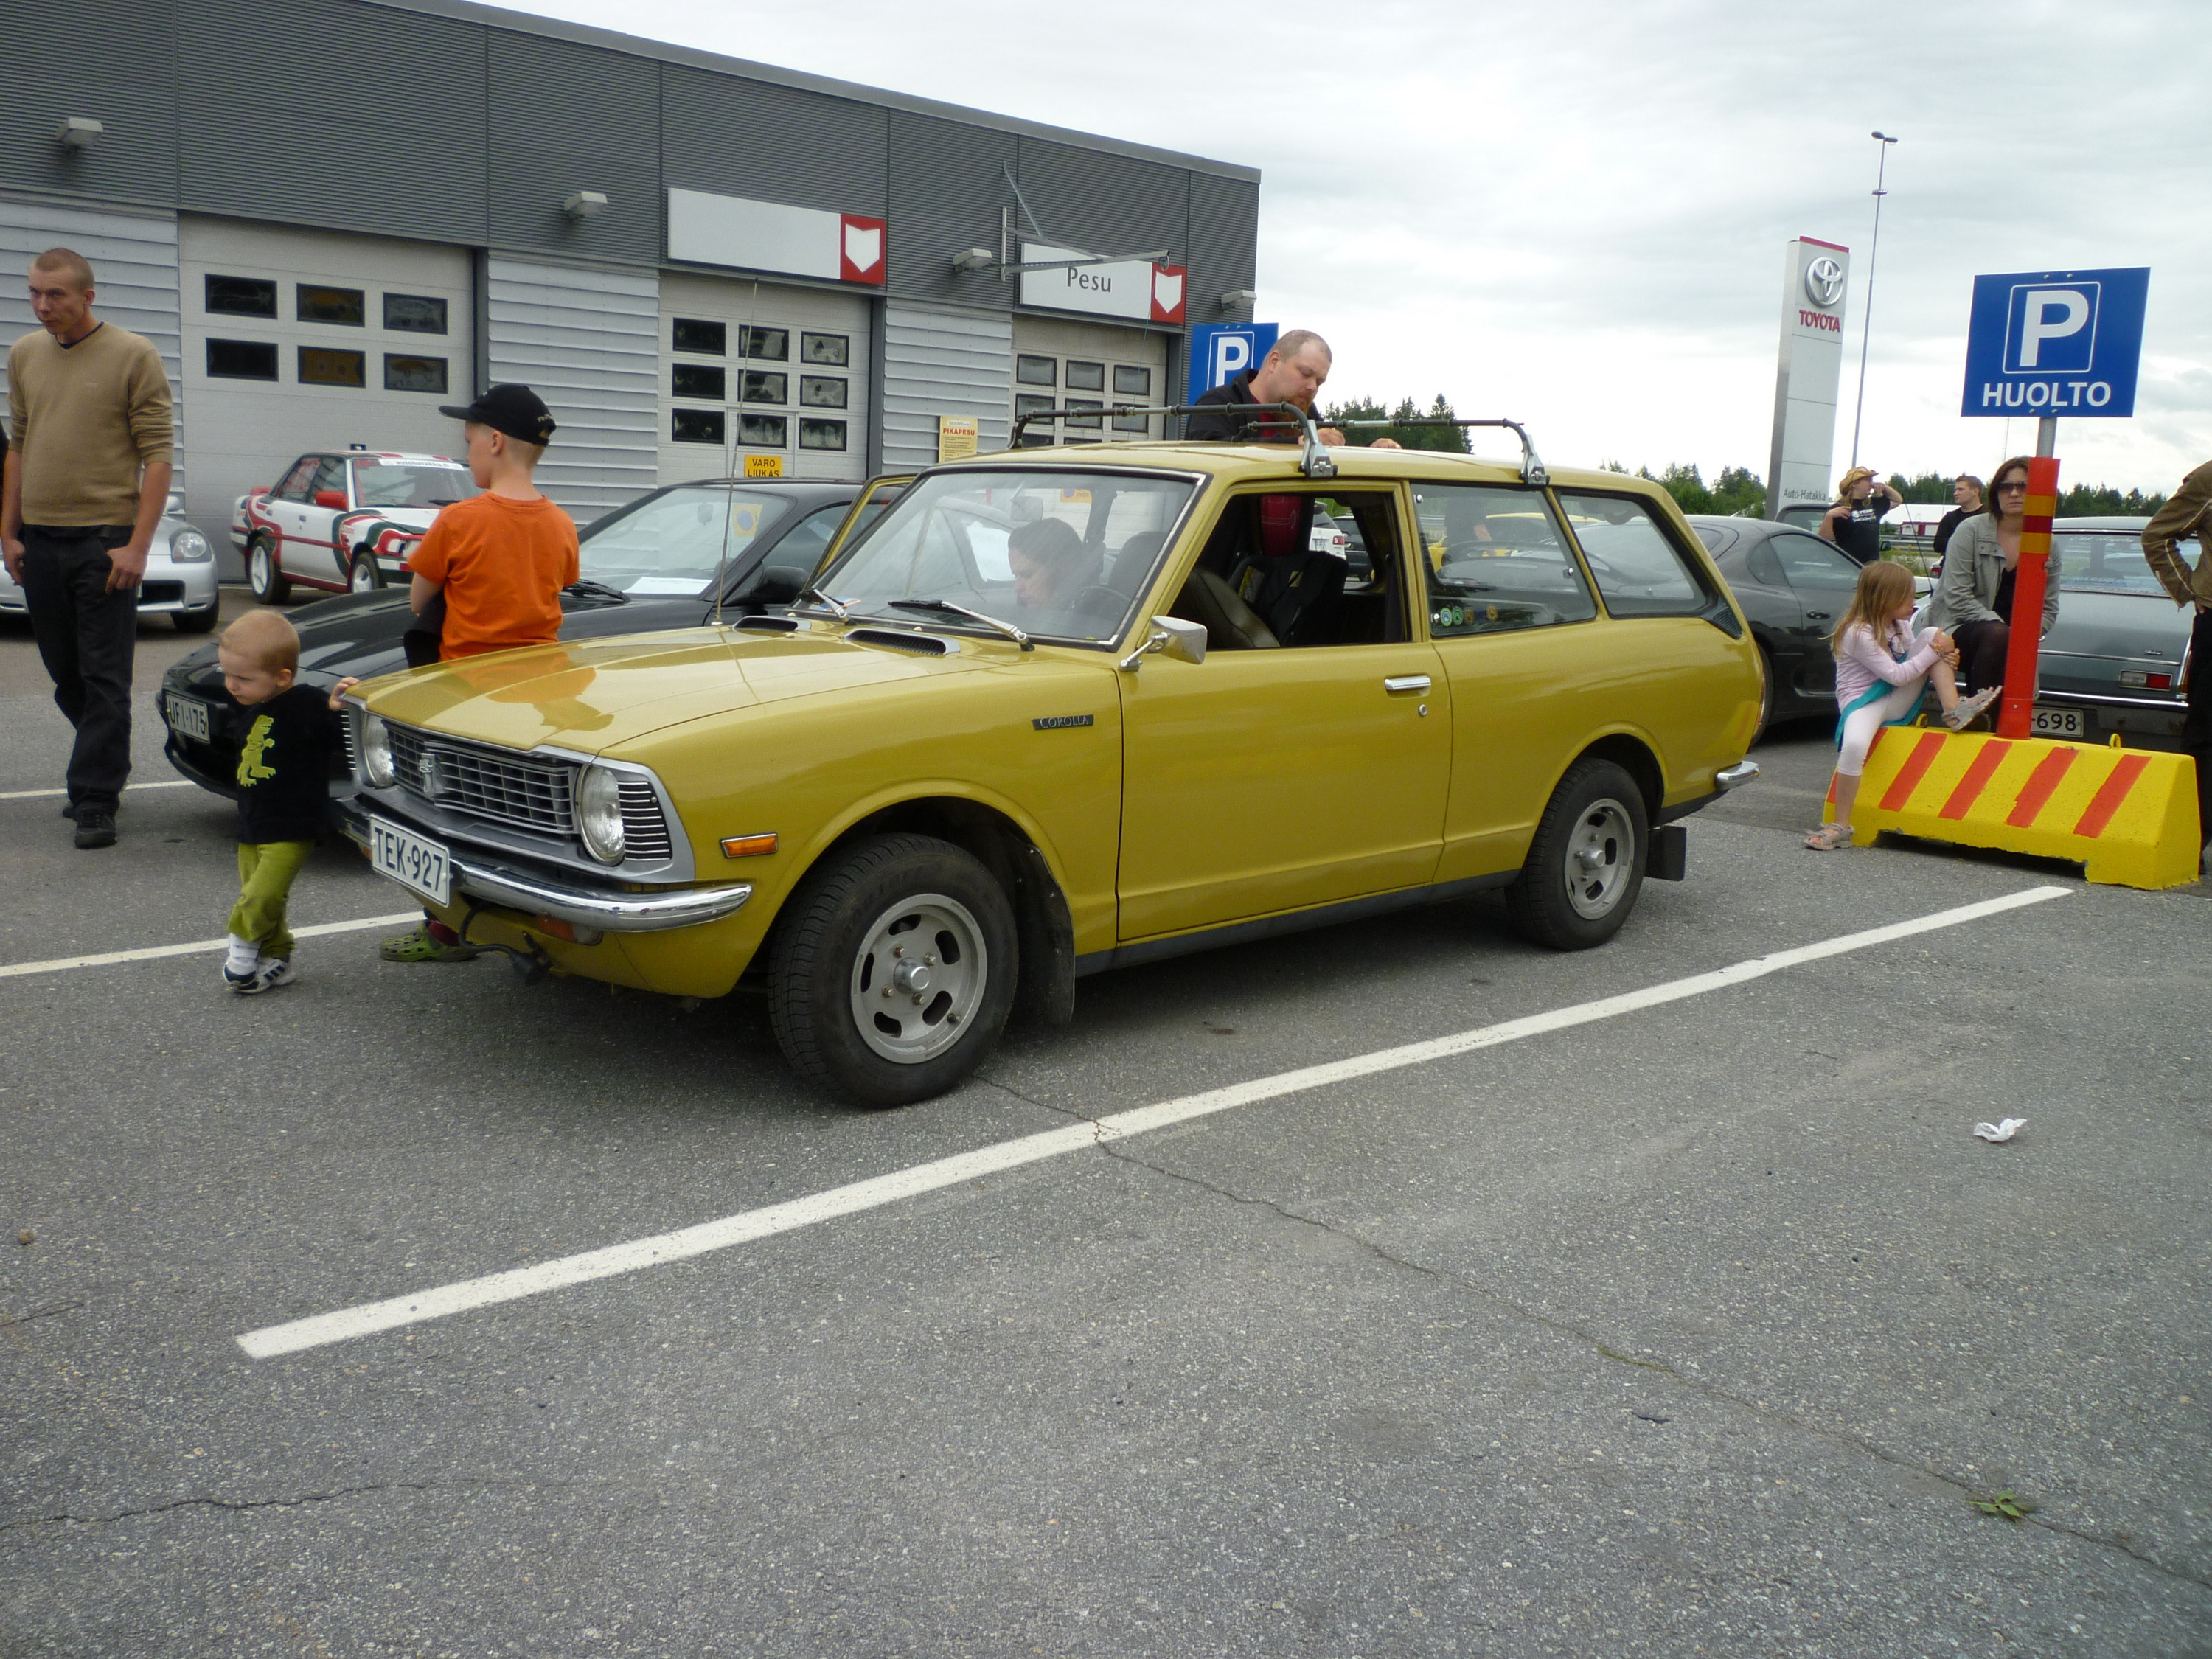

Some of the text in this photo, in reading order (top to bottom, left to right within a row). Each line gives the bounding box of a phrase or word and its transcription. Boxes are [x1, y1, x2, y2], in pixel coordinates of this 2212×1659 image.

[1067, 266, 1111, 293] Pesu
[1799, 309, 1840, 333] TOYOTA
[2019, 290, 2089, 366] P
[1215, 336, 1250, 387] P
[1982, 381, 2112, 407] HUOLTO
[942, 428, 975, 436] PIKAPESU
[752, 458, 776, 467] VARO
[1783, 488, 1826, 501] Auto-Hatakka
[168, 699, 206, 735] UFI-175
[1040, 715, 1089, 729] COROLLA
[374, 826, 443, 893] TEK-927
